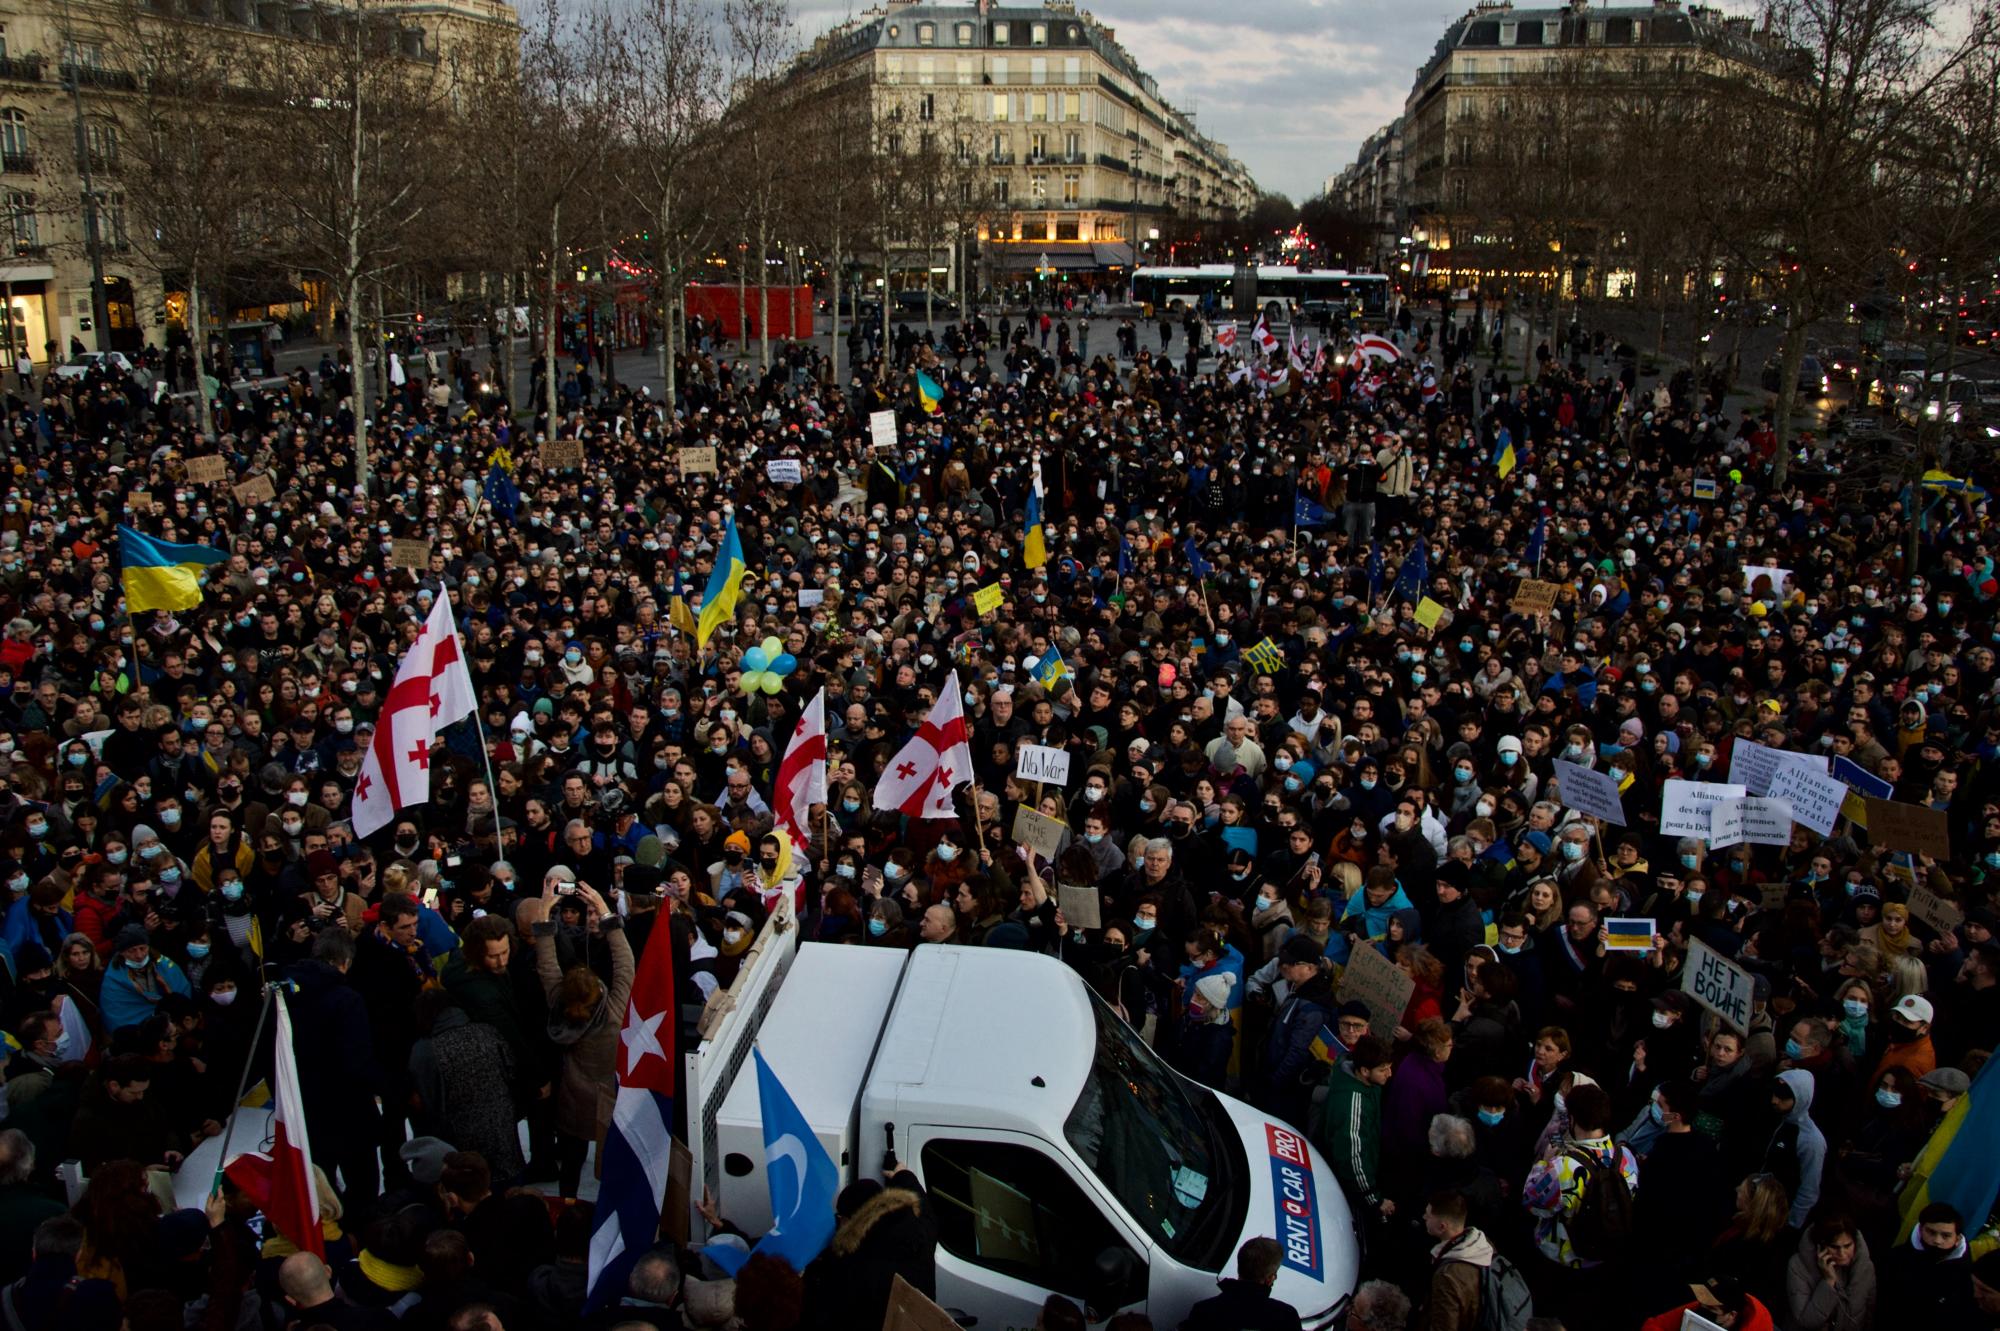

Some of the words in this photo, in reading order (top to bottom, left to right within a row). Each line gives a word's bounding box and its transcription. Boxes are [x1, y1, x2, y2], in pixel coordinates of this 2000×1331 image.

[1021, 750, 1038, 776] No
[1041, 751, 1066, 780] War
[1775, 770, 1793, 786] des
[1795, 779, 1841, 809] Femmes
[1790, 767, 1835, 795] Alliance
[1690, 790, 1726, 802] Alliance
[1735, 803, 1769, 813] Alliance
[1782, 787, 1809, 806] pour
[1812, 795, 1824, 812] la
[1679, 805, 1693, 815] des
[1725, 817, 1739, 827] des
[1665, 820, 1684, 833] pour
[1685, 821, 1694, 831] la
[1715, 830, 1732, 844] pour
[1741, 829, 1787, 841] Démocratie
[1703, 951, 1741, 991] НЕТ
[1694, 971, 1747, 1026] ВОЙНЕ
[1274, 1129, 1299, 1162] PRO
[1281, 1166, 1305, 1202] CAR
[1286, 1200, 1302, 1215] a
[1285, 1215, 1311, 1268] RENT
